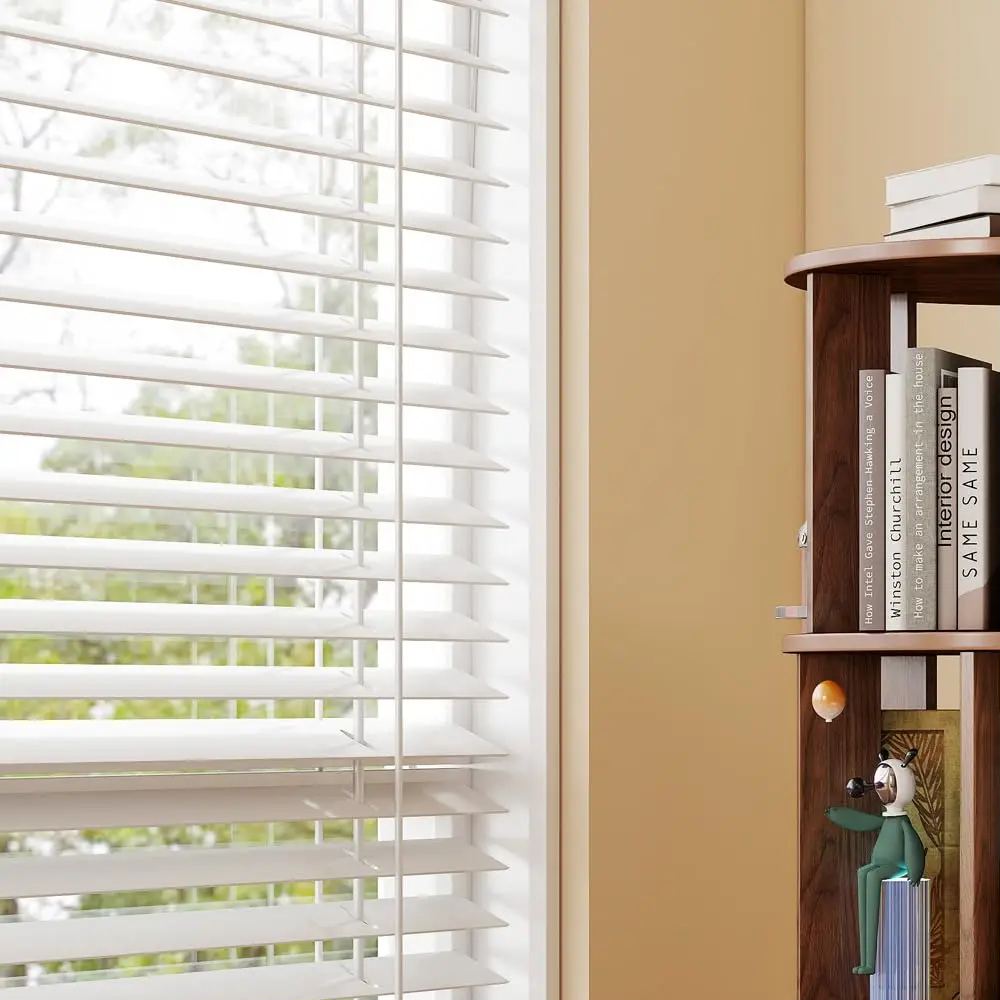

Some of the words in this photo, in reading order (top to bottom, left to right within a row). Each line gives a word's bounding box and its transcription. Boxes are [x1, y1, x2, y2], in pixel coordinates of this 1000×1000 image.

[914, 353, 924, 387] house
[864, 375, 873, 408] Voice
[913, 394, 923, 414] the
[913, 420, 923, 435] in
[937, 395, 957, 466] design
[864, 427, 875, 474] Hawking
[914, 442, 925, 517] arrangement
[962, 447, 978, 506] SAME
[864, 480, 875, 527] Stephen
[890, 457, 902, 542] Churchill
[938, 472, 953, 547] Interior
[864, 533, 873, 559] Gave
[915, 523, 923, 537] an
[913, 543, 923, 570] make
[962, 519, 978, 578] SAME
[864, 565, 873, 598] Intel
[890, 551, 902, 619] Winston
[913, 576, 923, 590] to
[865, 605, 873, 625] How
[913, 601, 923, 619] How
